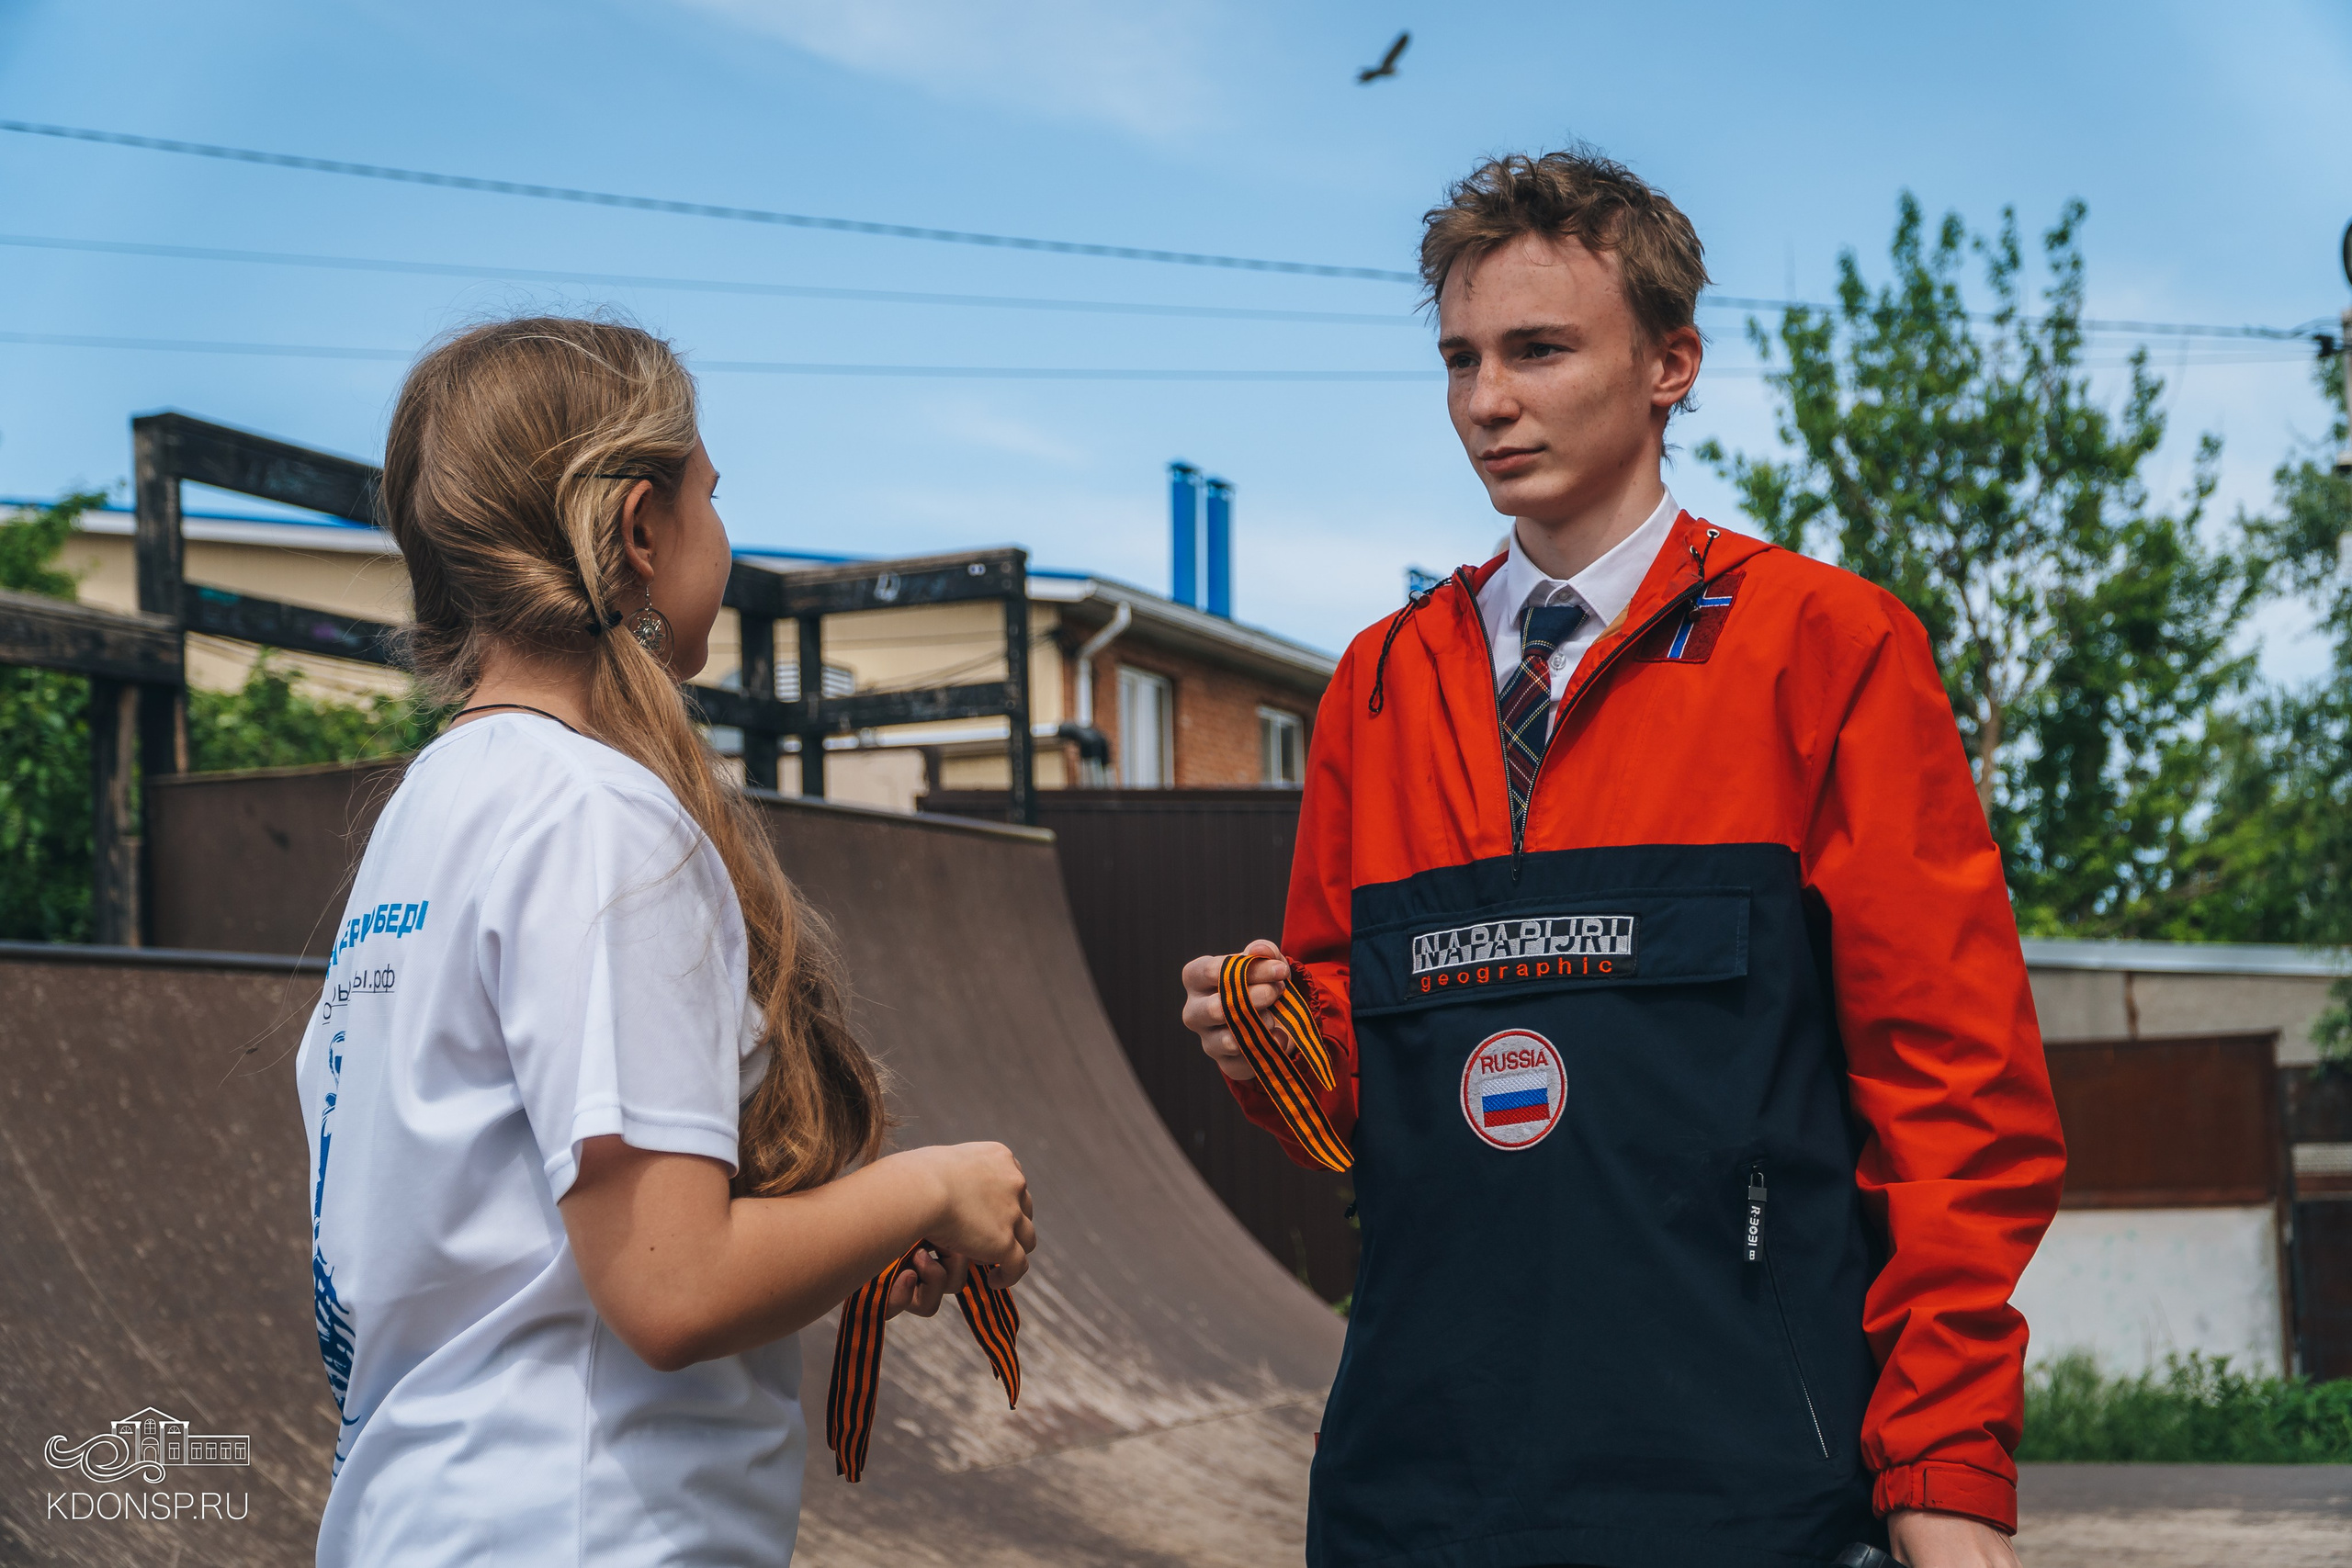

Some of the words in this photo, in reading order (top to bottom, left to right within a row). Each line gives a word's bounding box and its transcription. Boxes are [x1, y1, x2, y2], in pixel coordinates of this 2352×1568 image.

[1420, 919, 1620, 969] NAPAPIJRI
[1420, 957, 1612, 992] geographic
[1480, 1048, 1549, 1075] RUSSIA
